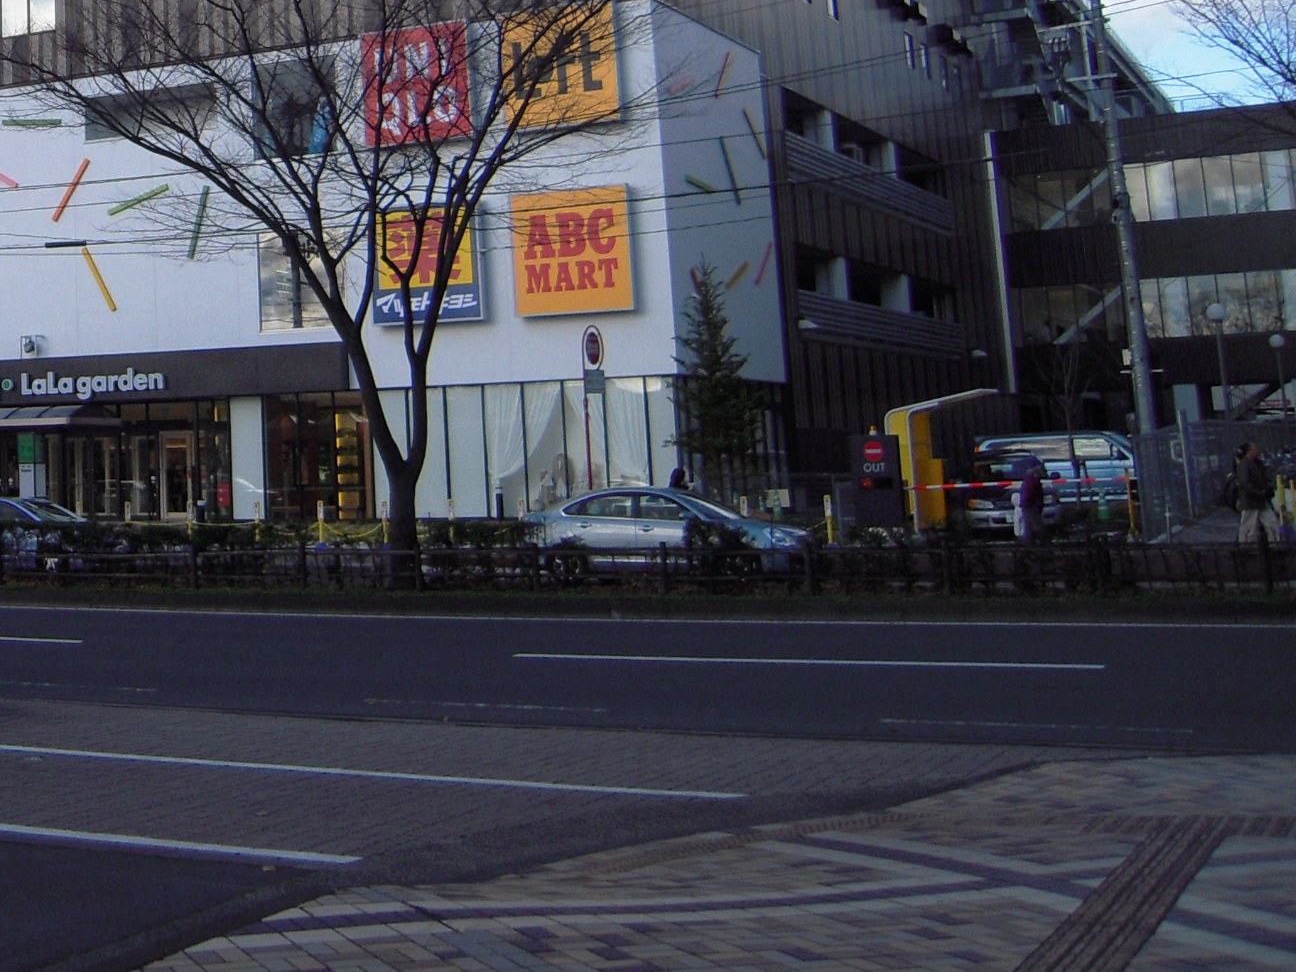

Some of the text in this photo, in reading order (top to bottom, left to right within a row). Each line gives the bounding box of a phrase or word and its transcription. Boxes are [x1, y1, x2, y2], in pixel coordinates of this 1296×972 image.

[524, 208, 616, 260] ABC
[525, 257, 618, 294] MART
[21, 367, 165, 400] LaLa garden
[863, 462, 885, 473] OUT
